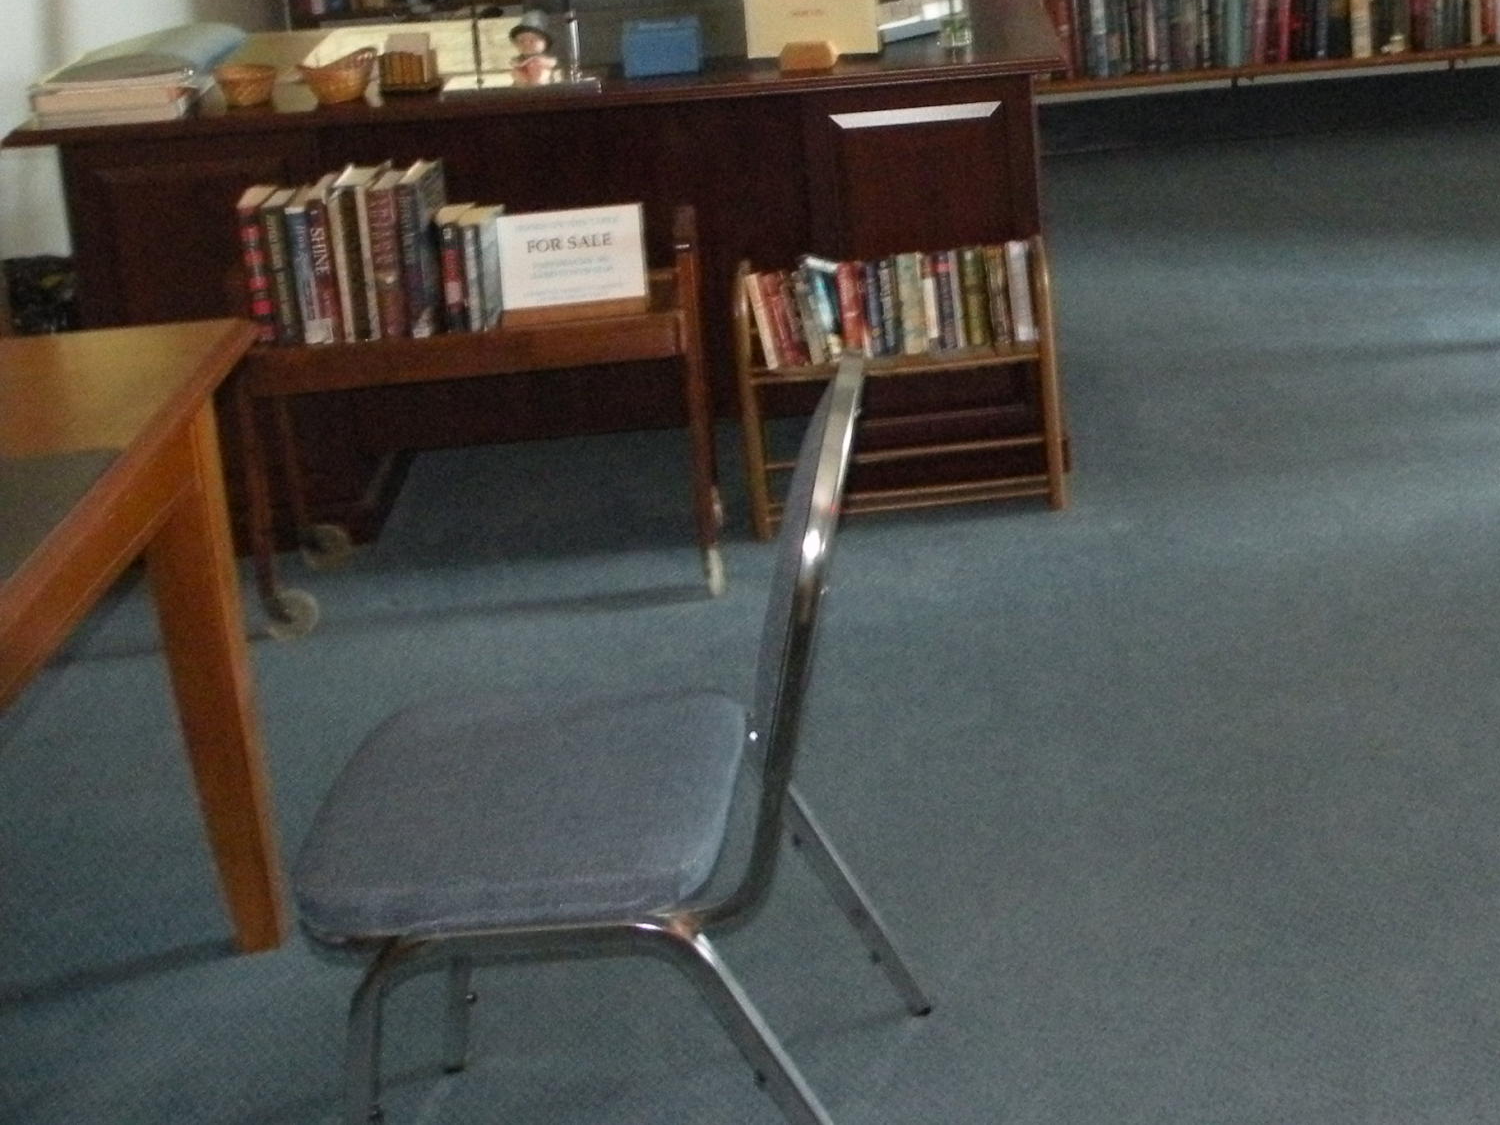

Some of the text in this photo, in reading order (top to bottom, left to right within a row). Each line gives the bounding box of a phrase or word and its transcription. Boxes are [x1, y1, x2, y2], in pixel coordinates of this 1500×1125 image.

[310, 227, 330, 274] SHINE
[527, 233, 612, 253] FOR SALE
